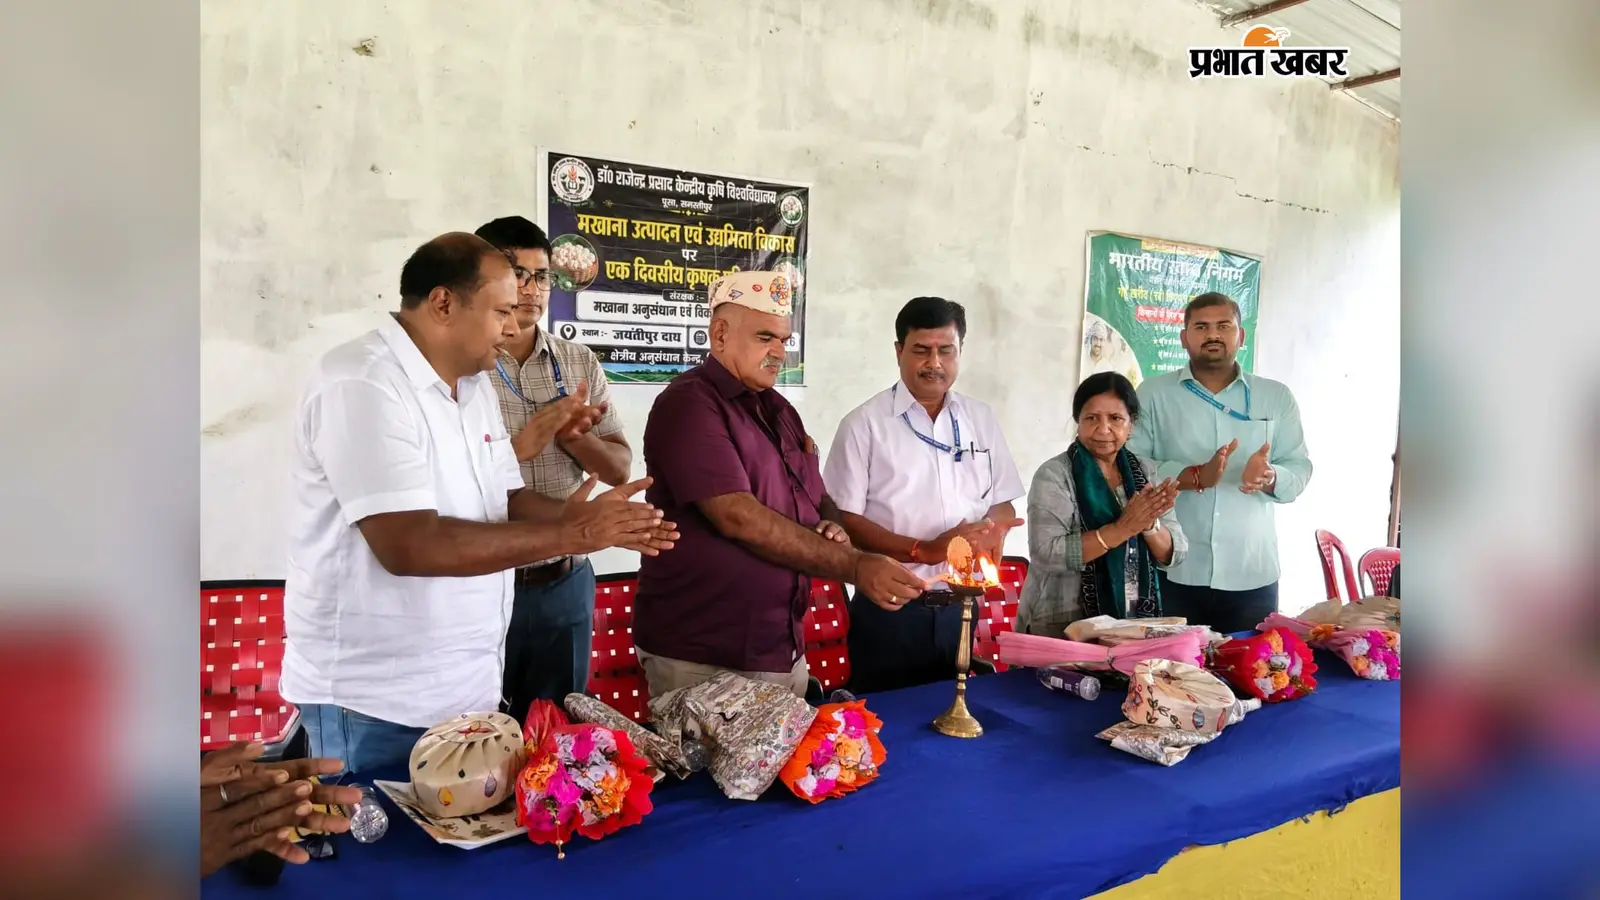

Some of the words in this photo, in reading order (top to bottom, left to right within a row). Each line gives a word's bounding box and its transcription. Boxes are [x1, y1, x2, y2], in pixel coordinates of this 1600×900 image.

[615, 168, 646, 189] राजेन्द्र
[648, 174, 674, 192] प्रसाद
[675, 175, 705, 196] केन्द्रीय
[707, 180, 725, 201] कृषि
[726, 182, 777, 204] विश्वविद्यालय
[680, 199, 713, 213] समस्तीपुर
[577, 213, 629, 238] मखाना
[631, 219, 681, 243] उत्पादन
[683, 221, 703, 245] एवं
[705, 223, 754, 250] उद्यमिता
[755, 226, 796, 253] विकास
[681, 249, 698, 261] पर
[605, 261, 631, 280] एक
[634, 257, 684, 284] दिवसीय
[1108, 252, 1164, 273] भारतीय
[1207, 260, 1246, 283] निगम
[669, 290, 694, 301] संरक्षक
[593, 301, 629, 315] मखाना
[632, 301, 677, 319] अनुसंधान
[680, 305, 693, 318] एवं
[694, 304, 712, 319] विक
[581, 329, 600, 337] स्थान
[612, 328, 659, 345] जयंतीपुर
[610, 348, 637, 362] क्षेत्रीय
[639, 350, 680, 366] अनुसंधान
